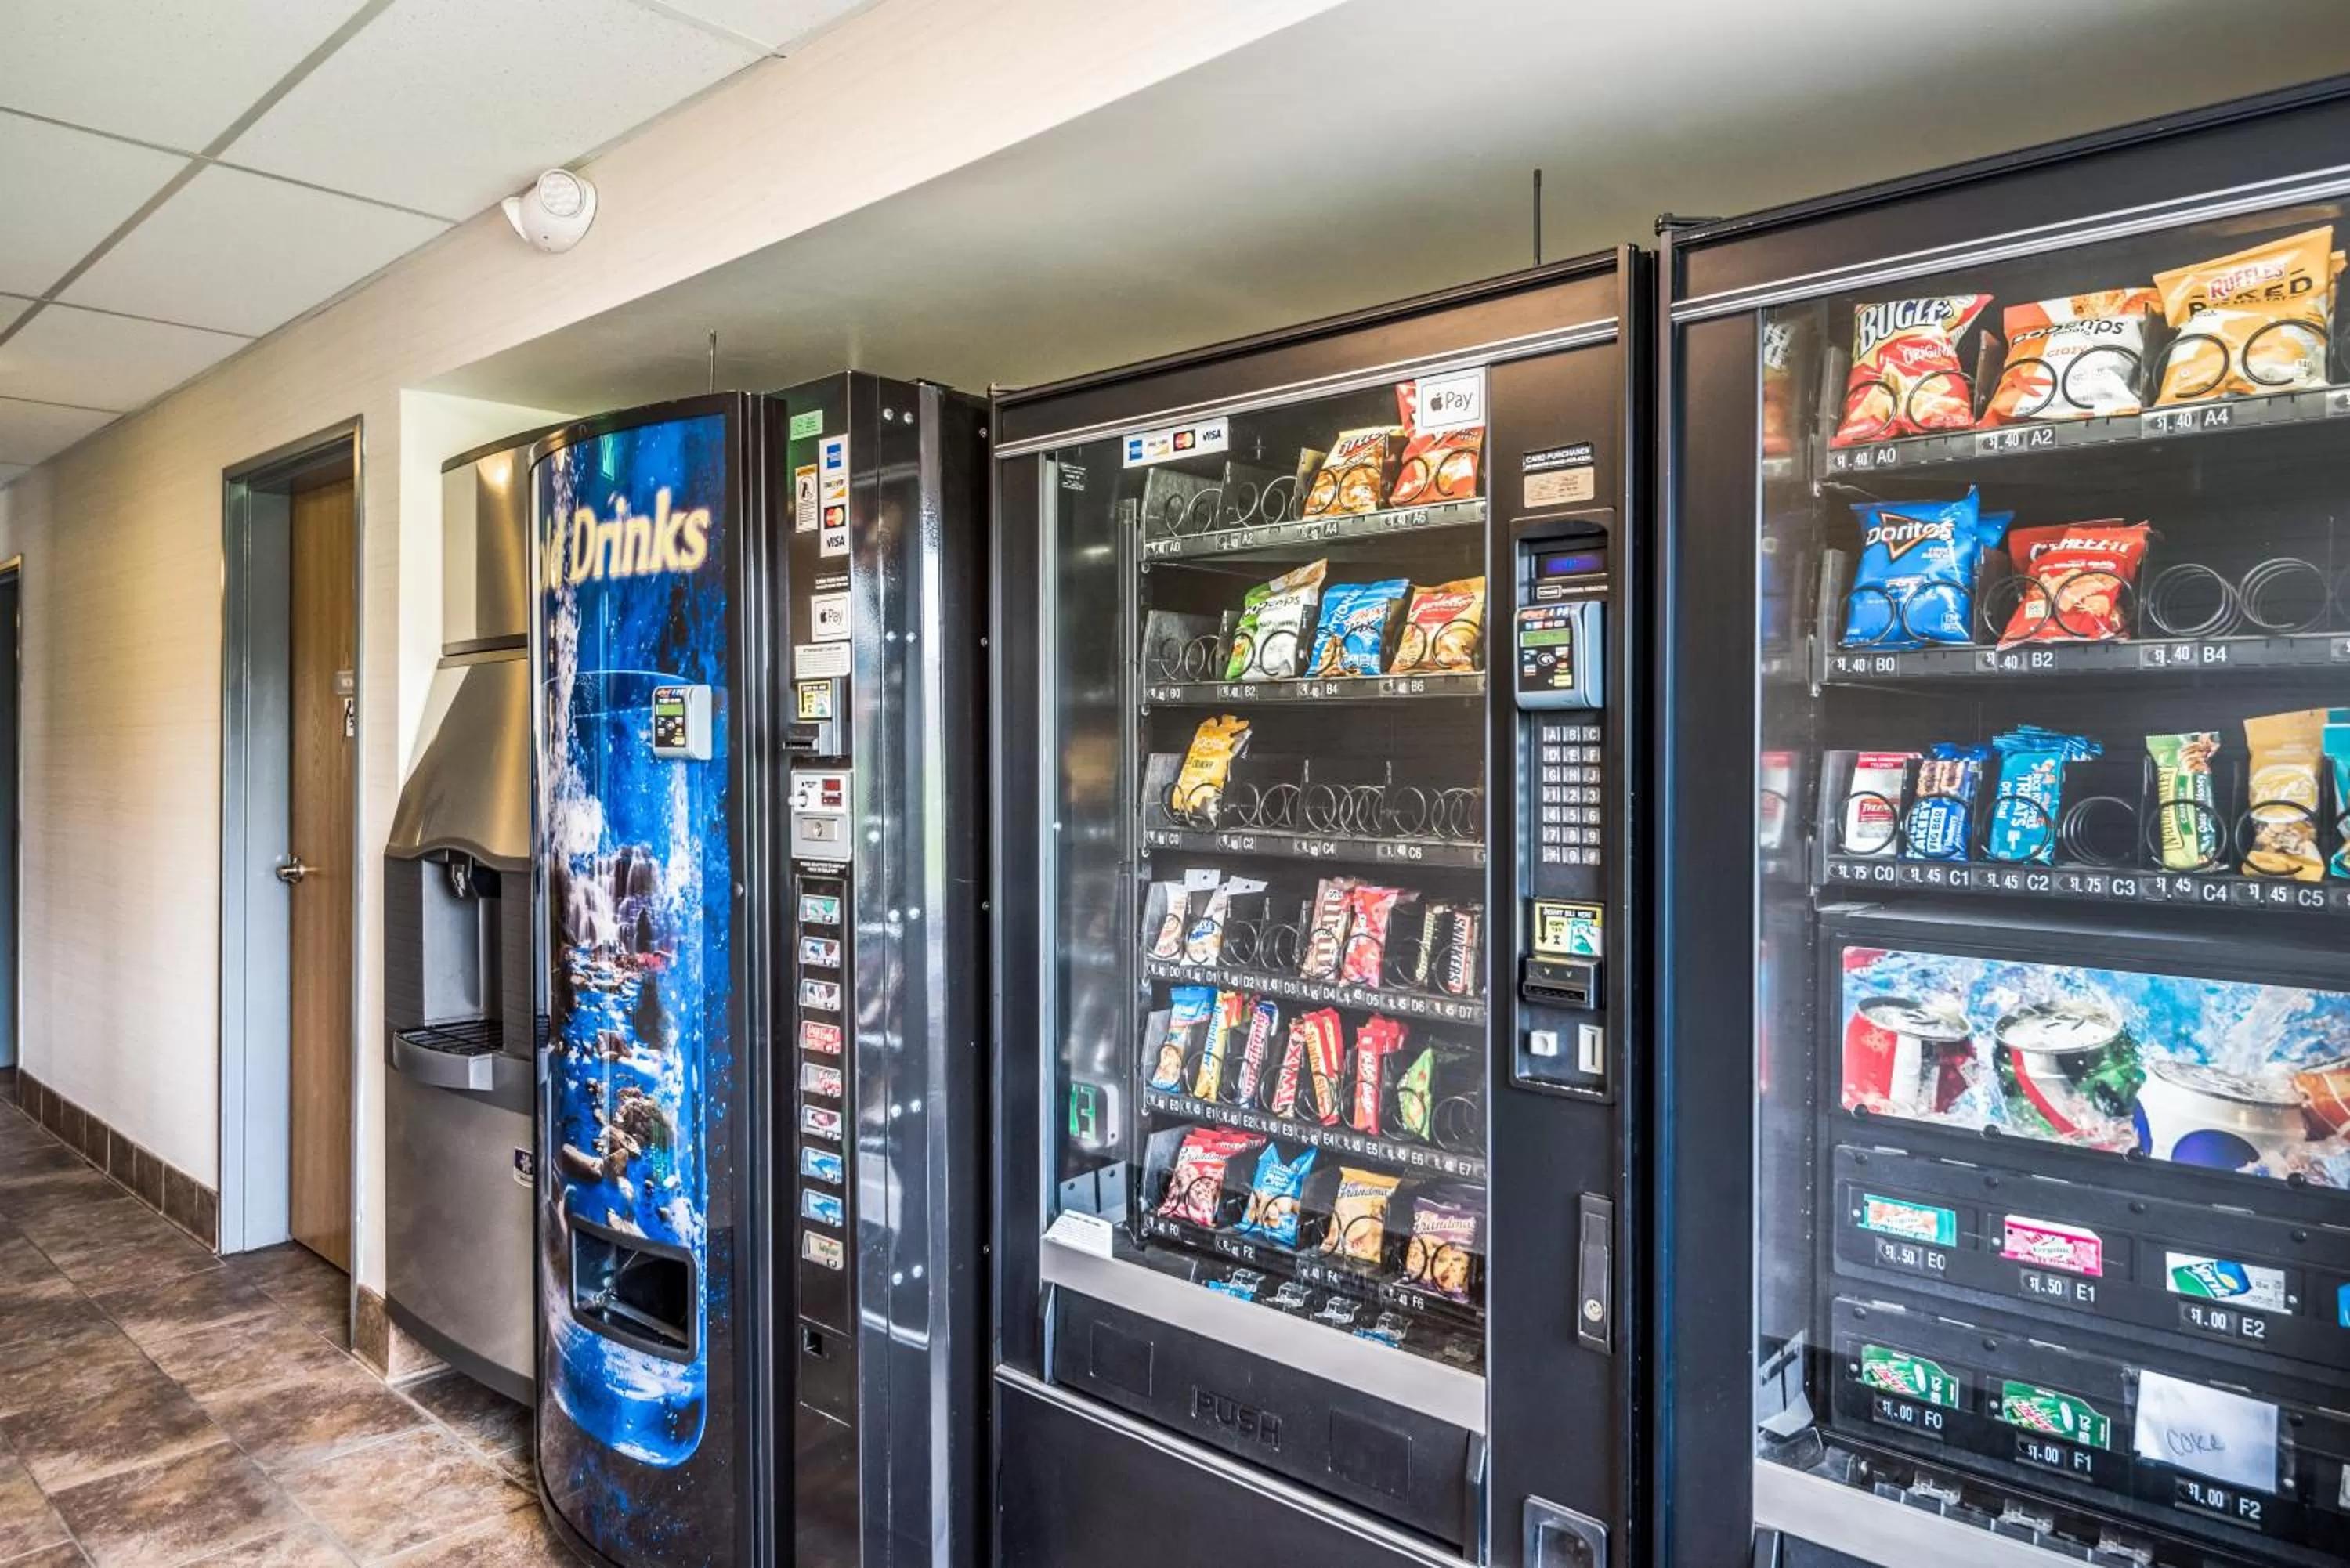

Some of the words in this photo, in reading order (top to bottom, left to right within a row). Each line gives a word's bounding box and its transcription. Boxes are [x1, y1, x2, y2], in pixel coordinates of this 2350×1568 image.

[1445, 392, 1473, 410] Pay
[2204, 409, 2229, 426] A4
[1202, 430, 1221, 442] VISA
[2031, 429, 2052, 446] A2
[1877, 449, 1896, 464] A0
[569, 486, 711, 586] Drinks
[827, 536, 845, 548] VISA
[828, 609, 844, 625] Pay
[2032, 652, 2053, 670] B2
[2204, 645, 2228, 663] B4
[1930, 810, 1944, 830] BAR
[1323, 842, 1335, 854] C4
[1408, 847, 1422, 859] C6
[1929, 832, 1943, 852] FIG
[1875, 866, 1894, 882] C0
[1950, 870, 1969, 886] C1
[2027, 875, 2049, 891] C2
[2113, 880, 2135, 896] C3
[2203, 885, 2227, 901] C4
[2298, 890, 2324, 907] C5
[1449, 918, 1466, 985] SNICKERS
[1243, 977, 1254, 988] D2
[1323, 988, 1336, 1000] D4
[1366, 994, 1379, 1006] D5
[1412, 999, 1425, 1012] D6
[1459, 1006, 1472, 1019] D7
[1273, 1042, 1303, 1110] TWIX
[1206, 1107, 1215, 1119] E1
[1243, 1115, 1253, 1127] E2
[1282, 1123, 1293, 1135] E3
[1323, 1133, 1334, 1146] E4
[1365, 1142, 1378, 1155] E5
[1412, 1152, 1423, 1165] E6
[1459, 1162, 1472, 1176] E7
[1170, 1223, 1179, 1236] F0
[1244, 1245, 1254, 1259] F2
[1412, 1295, 1424, 1310] F6
[1928, 1253, 1946, 1270] E0
[2030, 1277, 2062, 1296] $1.50
[2077, 1284, 2095, 1302] E1
[2191, 1308, 2227, 1330] $1.00
[2242, 1318, 2265, 1339] E2
[1191, 1384, 1285, 1452] PUSH
[1882, 1400, 1912, 1422] $1.00
[1925, 1411, 1942, 1430] F0
[2079, 1414, 2091, 1430] 12
[2028, 1443, 2059, 1464] $1.00
[2074, 1452, 2092, 1472] F1
[2189, 1482, 2223, 1508] $1.00
[2239, 1497, 2261, 1520] F2
